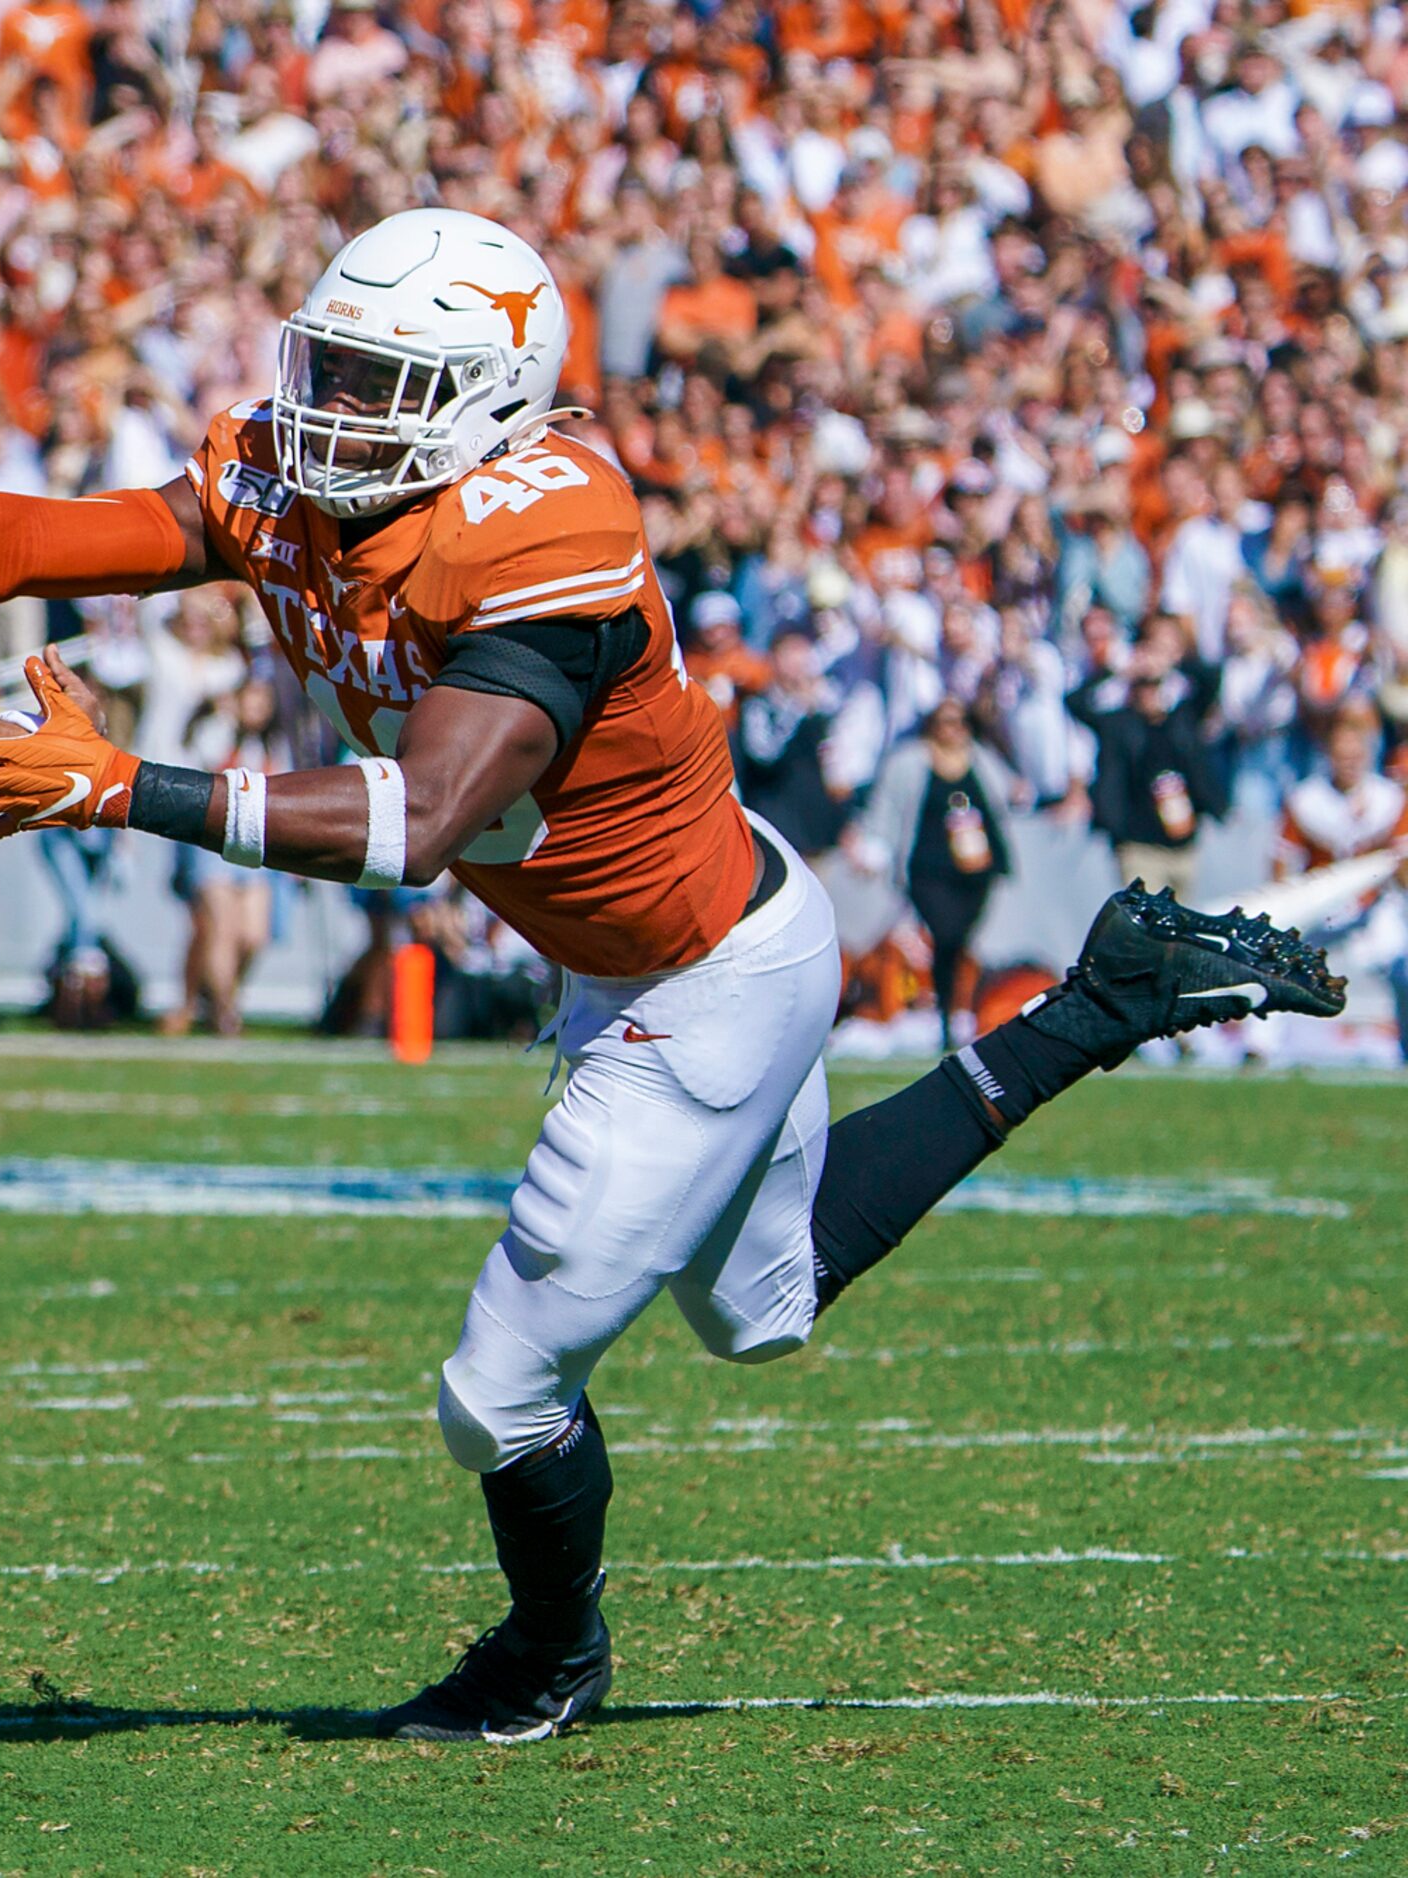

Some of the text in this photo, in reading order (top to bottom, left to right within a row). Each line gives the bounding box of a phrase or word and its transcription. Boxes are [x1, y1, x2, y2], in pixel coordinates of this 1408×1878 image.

[327, 299, 365, 320] HORNS
[220, 459, 298, 519] 150
[460, 448, 590, 525] 46
[261, 579, 433, 701] TEXAS
